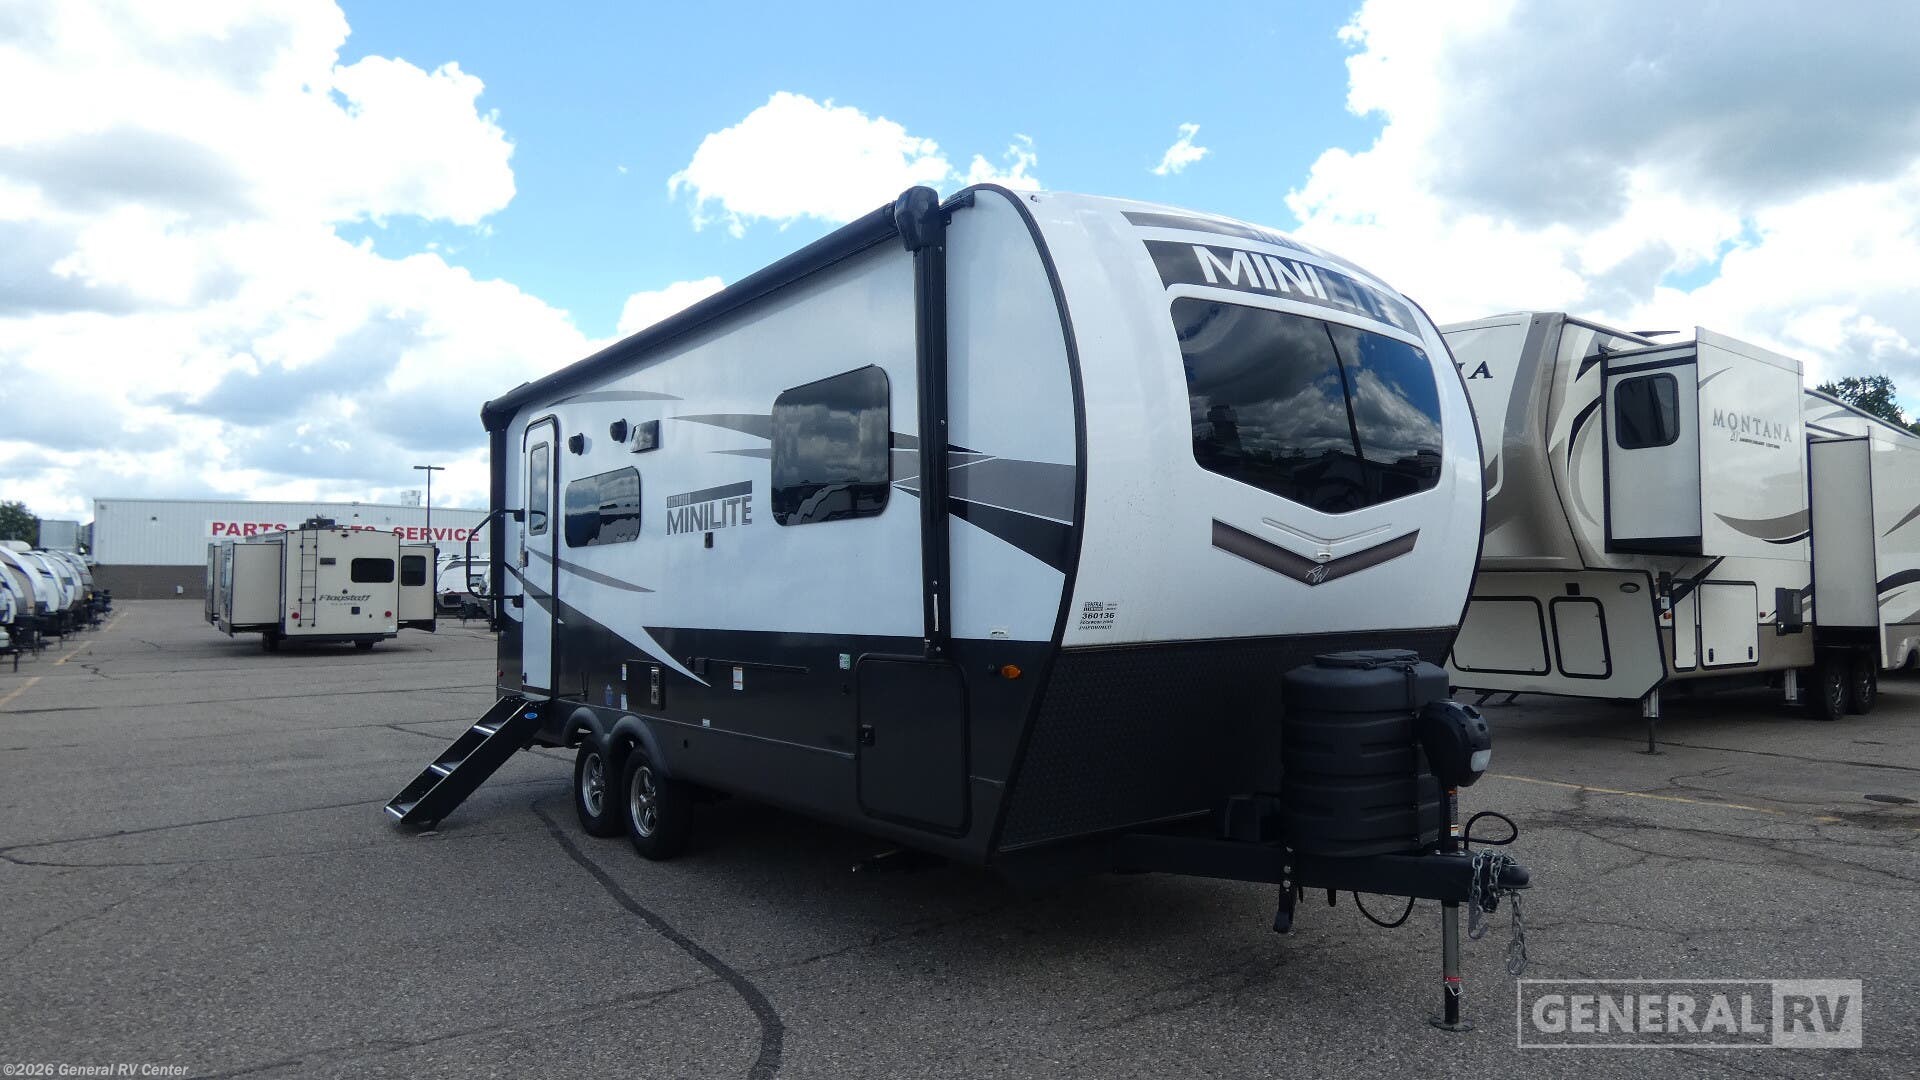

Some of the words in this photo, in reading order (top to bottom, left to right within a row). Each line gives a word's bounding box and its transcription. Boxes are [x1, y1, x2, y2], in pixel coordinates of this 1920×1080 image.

[1712, 408, 1793, 443] MONTANA
[666, 495, 752, 535] MINILITE
[393, 526, 480, 542] SERVICE
